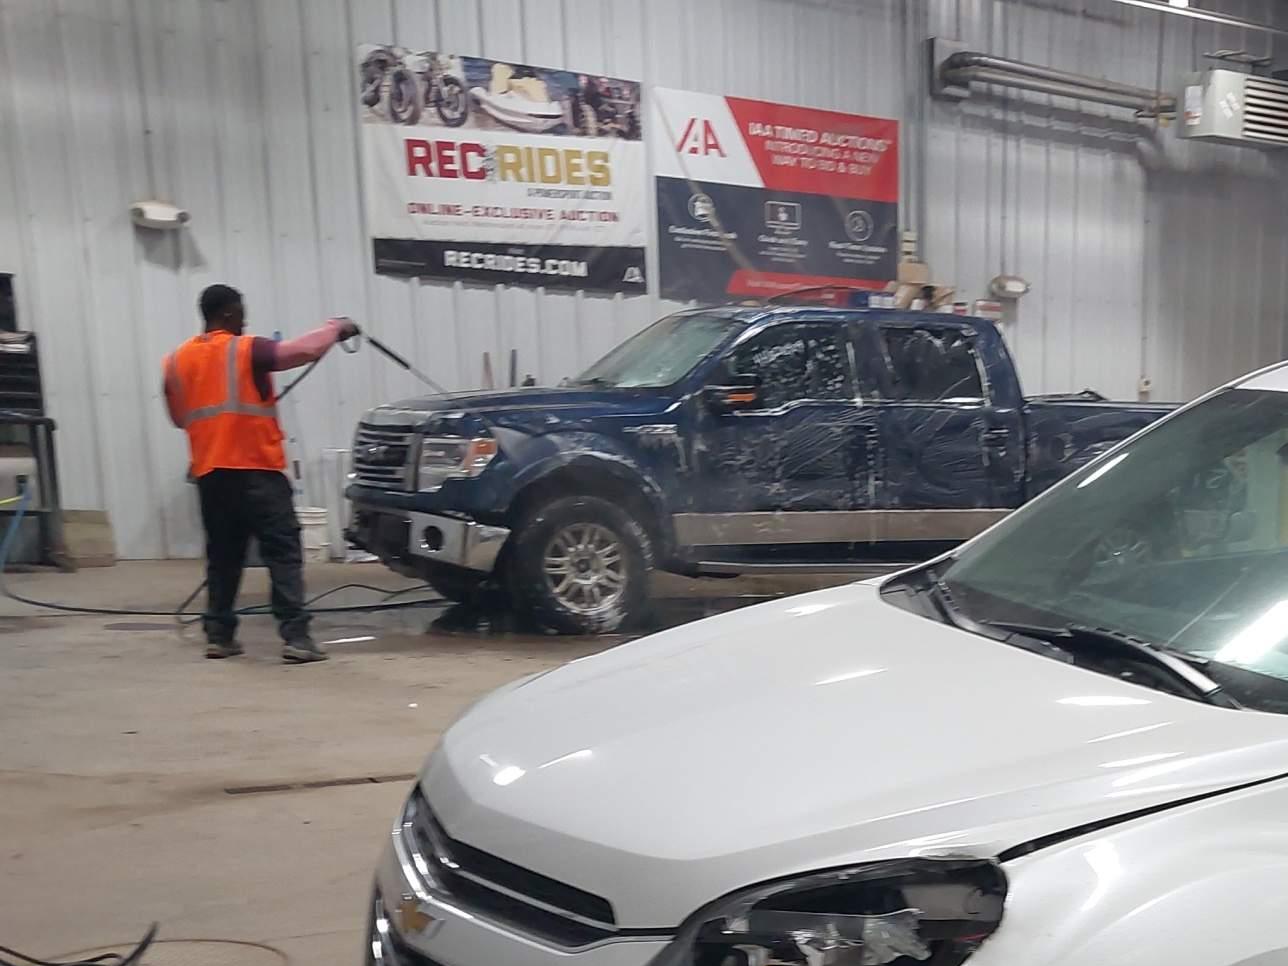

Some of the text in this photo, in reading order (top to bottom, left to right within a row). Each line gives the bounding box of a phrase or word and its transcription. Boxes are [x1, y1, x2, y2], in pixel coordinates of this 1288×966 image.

[774, 125, 818, 143] TIMED
[404, 139, 487, 180] REC
[496, 145, 612, 187] RIDES
[407, 202, 620, 223] ONLINE-EXCLUSIVE AUCTION
[443, 250, 588, 277] RECRIDES.COM
